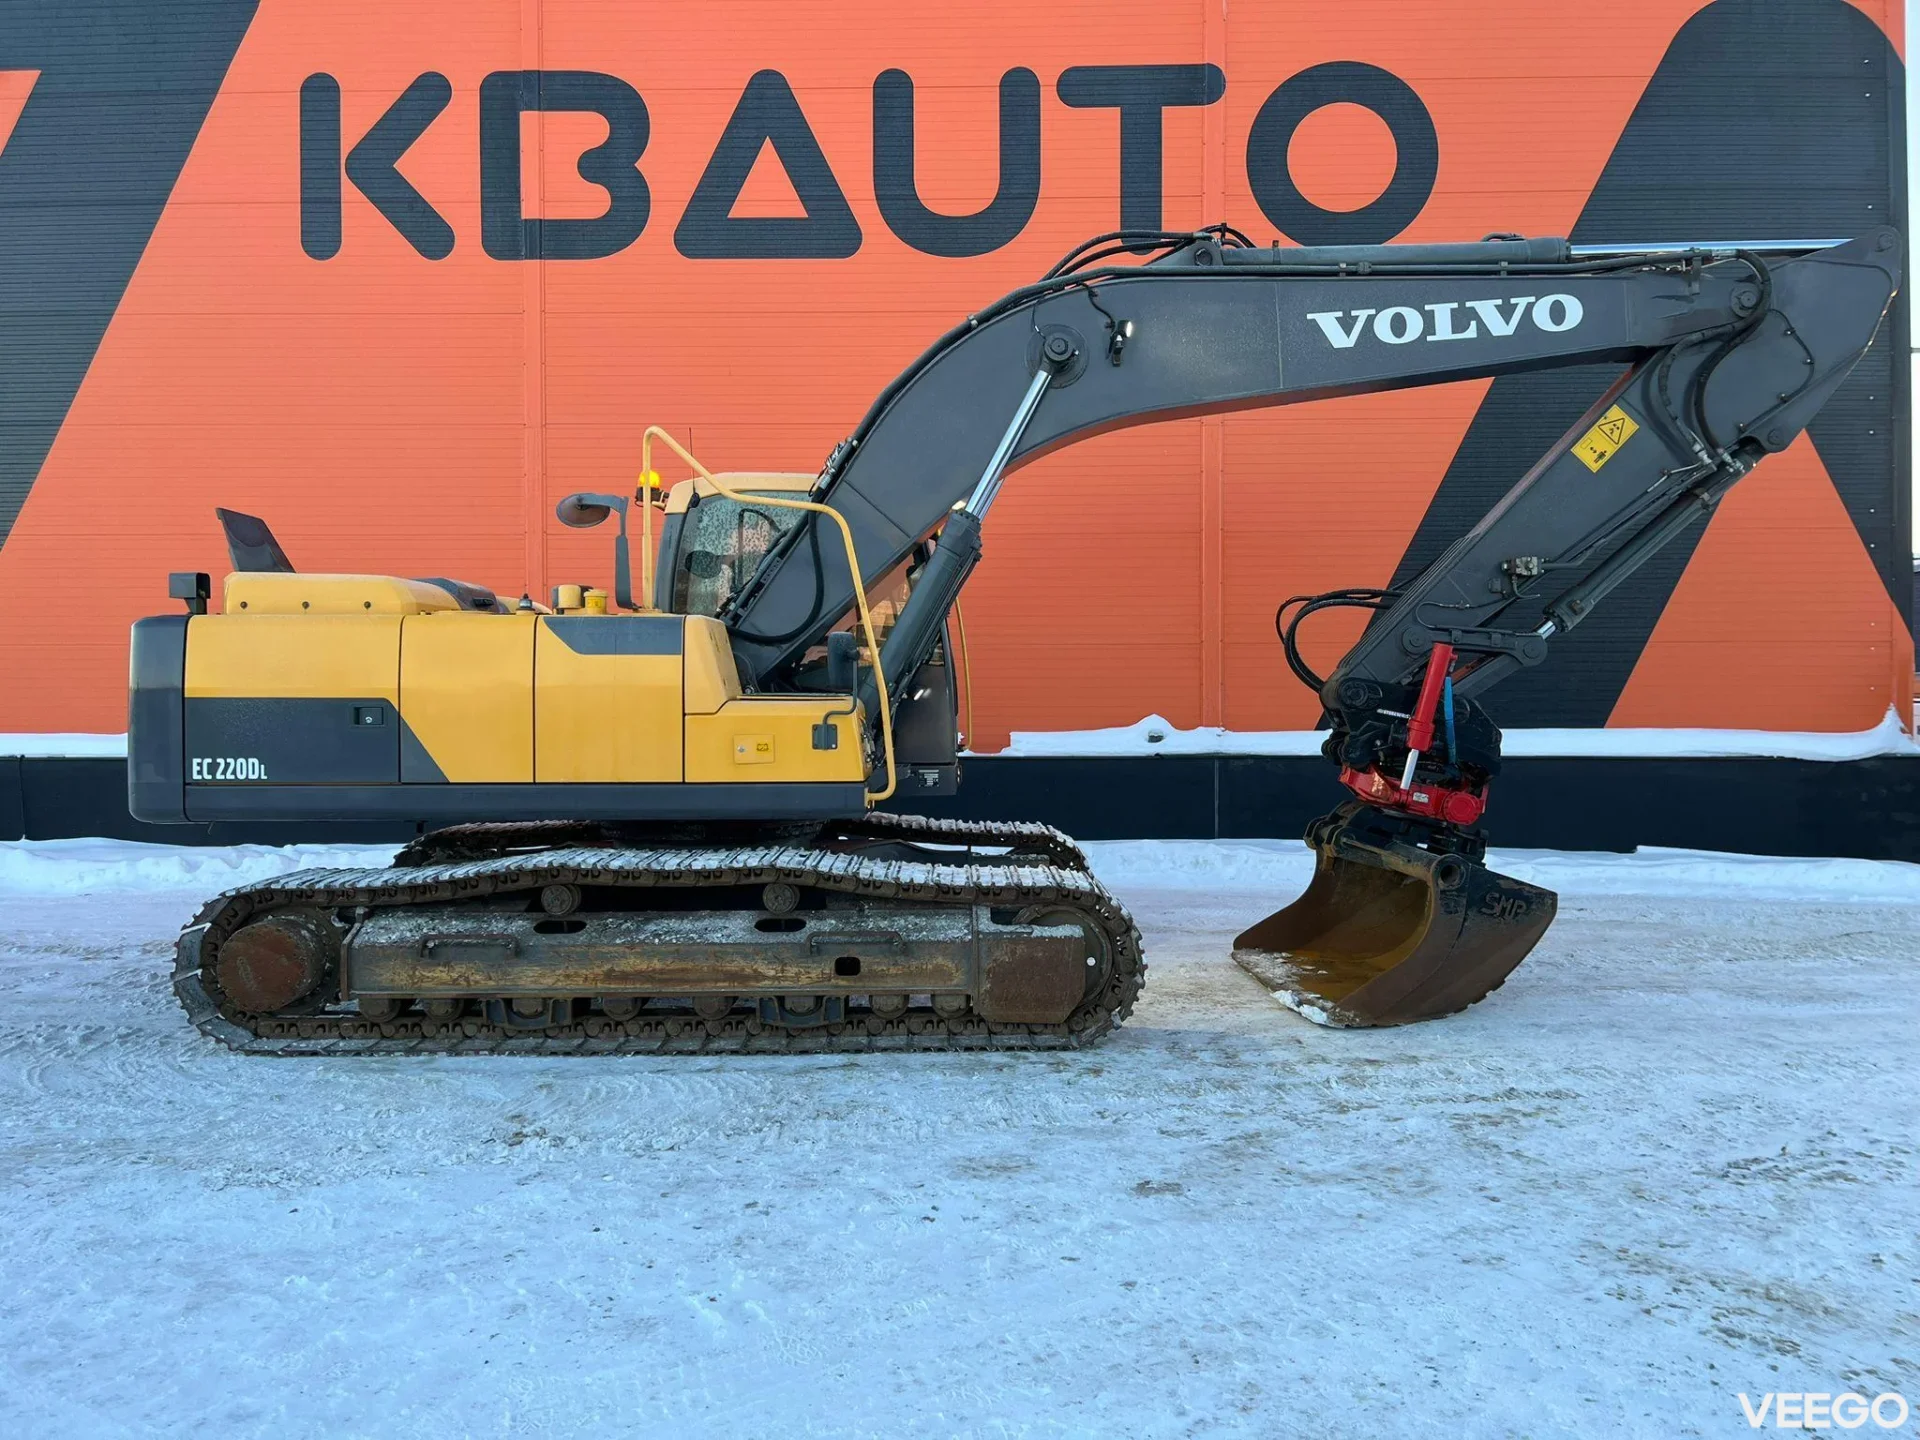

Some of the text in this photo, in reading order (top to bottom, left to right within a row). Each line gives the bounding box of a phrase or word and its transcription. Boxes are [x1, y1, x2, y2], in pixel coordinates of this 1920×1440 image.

[300, 60, 1438, 260] KBAUTO
[1306, 293, 1584, 349] VOLVO
[192, 757, 213, 780] EC
[1480, 892, 1527, 921] SMP
